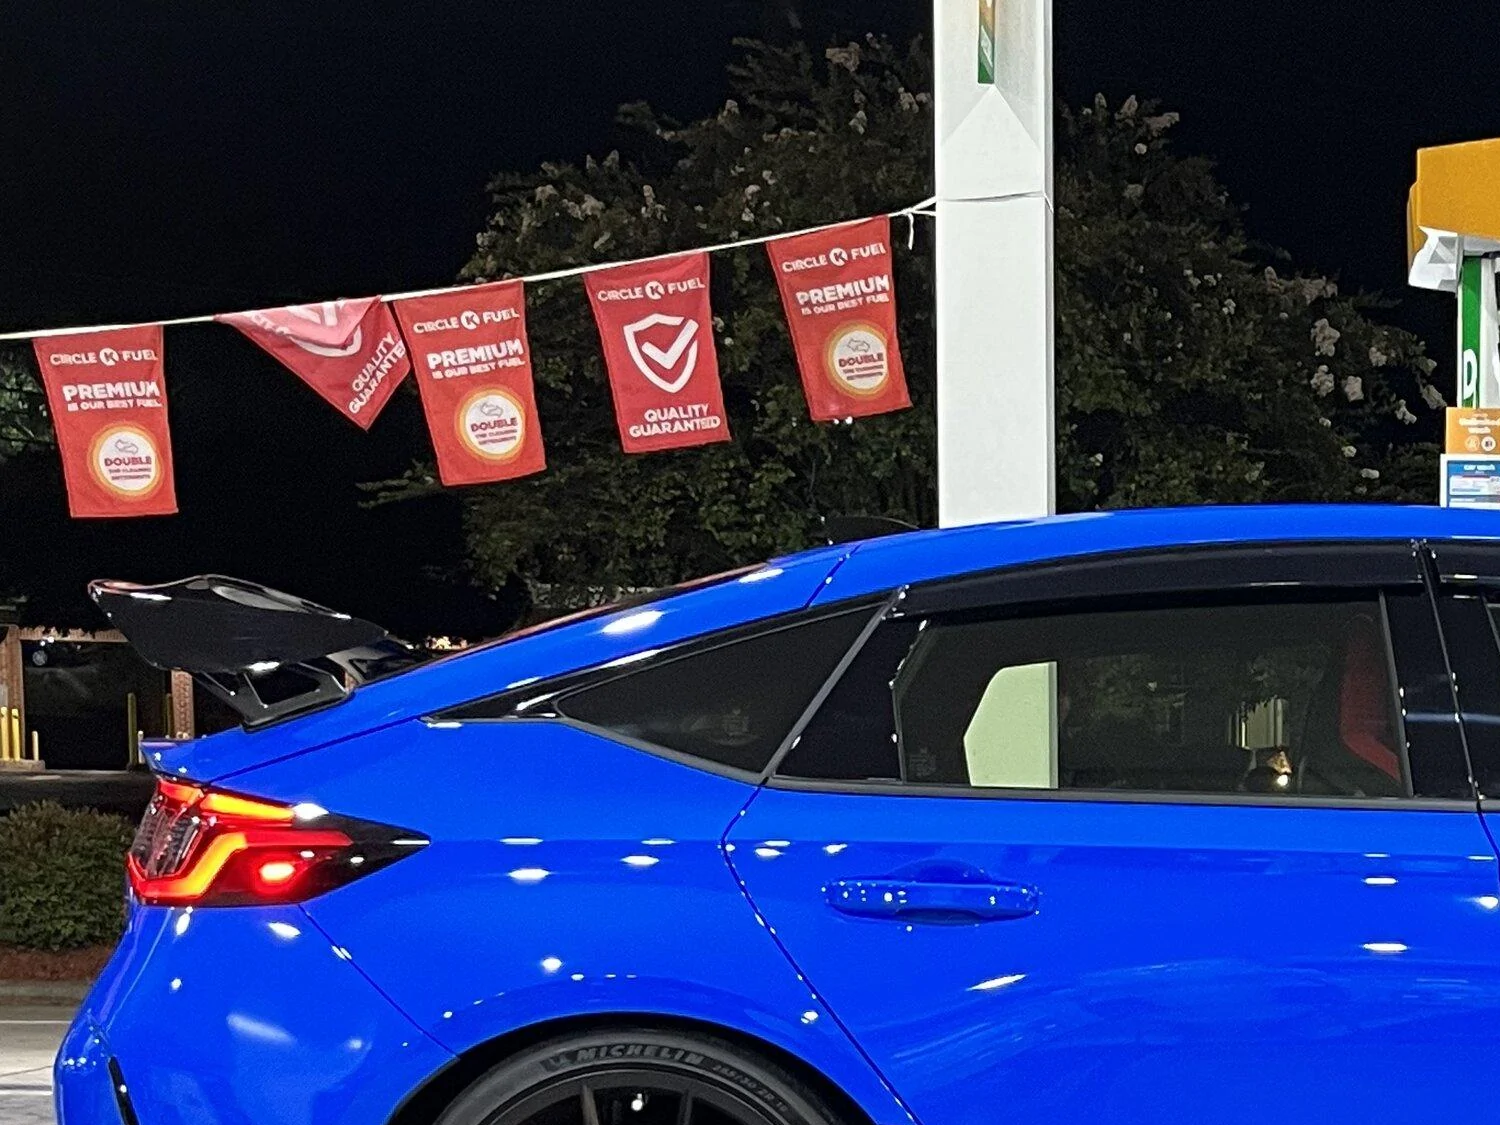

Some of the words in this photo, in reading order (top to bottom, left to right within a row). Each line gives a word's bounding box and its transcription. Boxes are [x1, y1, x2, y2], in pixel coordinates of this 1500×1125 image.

[782, 255, 828, 273] CIRCLE
[829, 248, 848, 266] K
[851, 243, 886, 260] FUEL
[598, 287, 643, 301] CIRCLE
[645, 281, 665, 300] K
[667, 277, 705, 294] FUEL
[796, 274, 890, 305] PREMIUM
[813, 304, 835, 314] OUR
[413, 317, 459, 333] CIRCLE
[460, 310, 480, 330] K
[482, 308, 520, 324] FUEL
[50, 352, 97, 365] CIRCLE
[100, 348, 119, 366] K
[122, 350, 158, 361] FUEL
[352, 332, 395, 392] QUALITY
[427, 338, 524, 369] PREMIUM
[839, 353, 884, 367] DOUBLE
[445, 367, 468, 378] OUR
[498, 358, 525, 368] FUEL
[62, 380, 160, 401] PREMIUM
[81, 401, 105, 410] OUR
[136, 399, 162, 407] FUEL
[644, 404, 709, 423] QUALITY
[471, 417, 518, 432] DOUBLE
[629, 416, 720, 437] GUARANTEED
[104, 456, 152, 467] DOUBLE
[576, 1043, 704, 1065] MICHELIN
